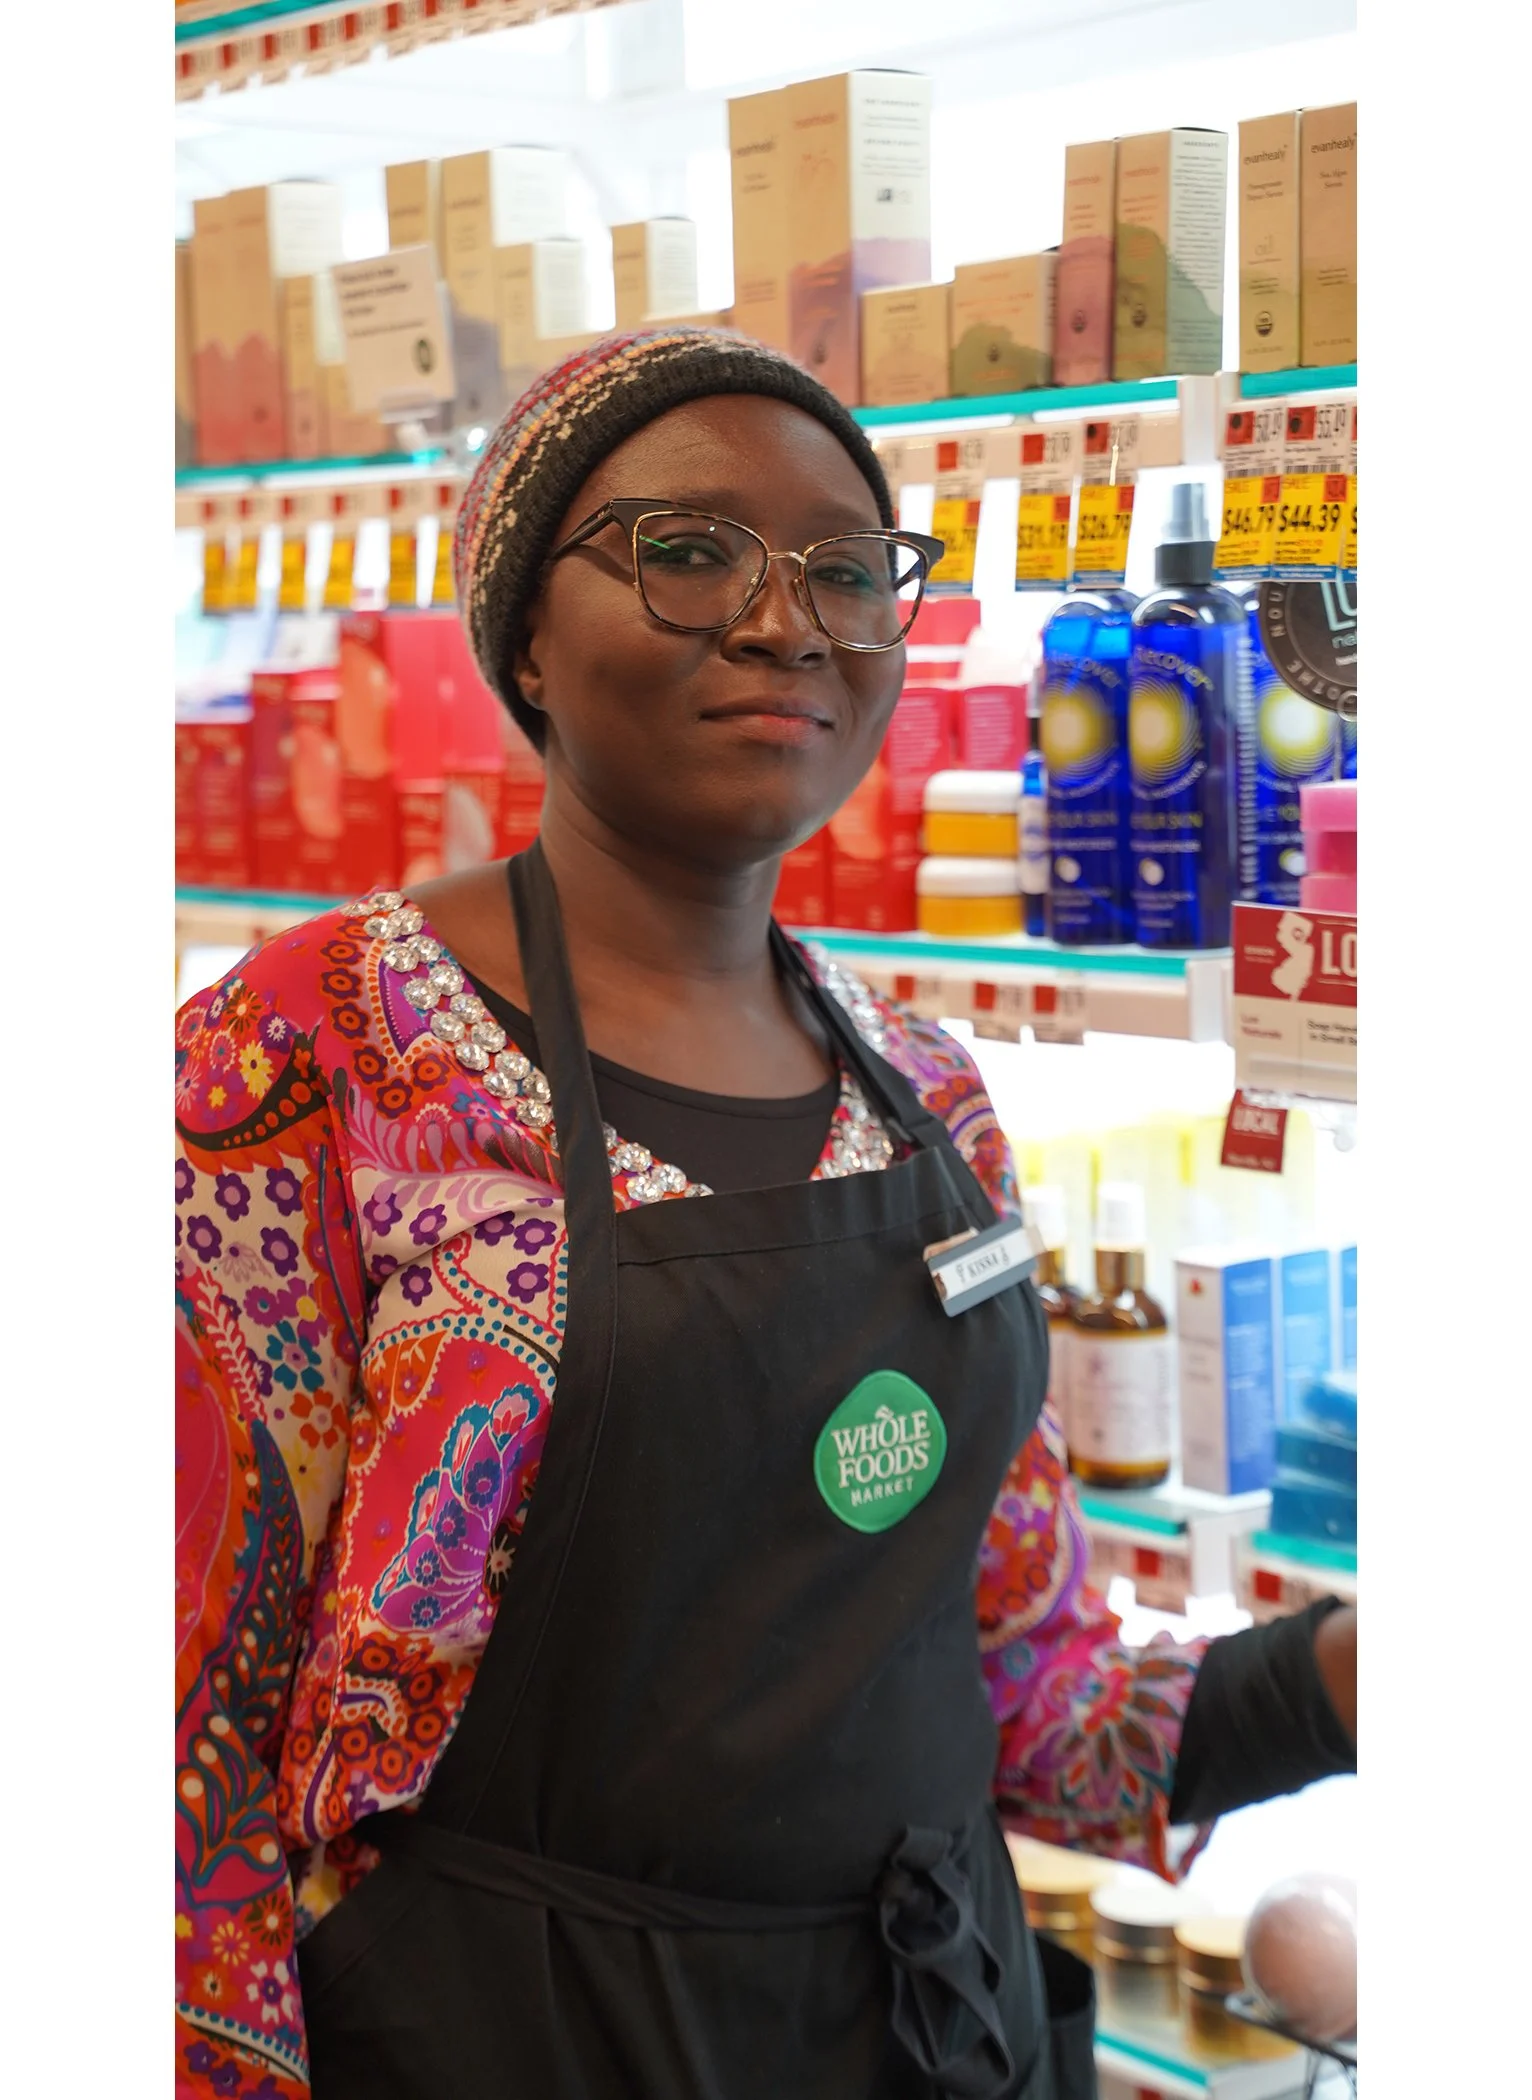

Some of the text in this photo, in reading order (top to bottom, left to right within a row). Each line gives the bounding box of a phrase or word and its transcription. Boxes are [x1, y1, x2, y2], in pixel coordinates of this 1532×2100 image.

[1310, 136, 1355, 154] evanhealy
[1279, 503, 1341, 533] $44.39
[831, 1407, 931, 1458] WHOLE
[838, 1441, 930, 1489] FOODS
[851, 1476, 913, 1507] MARKET
